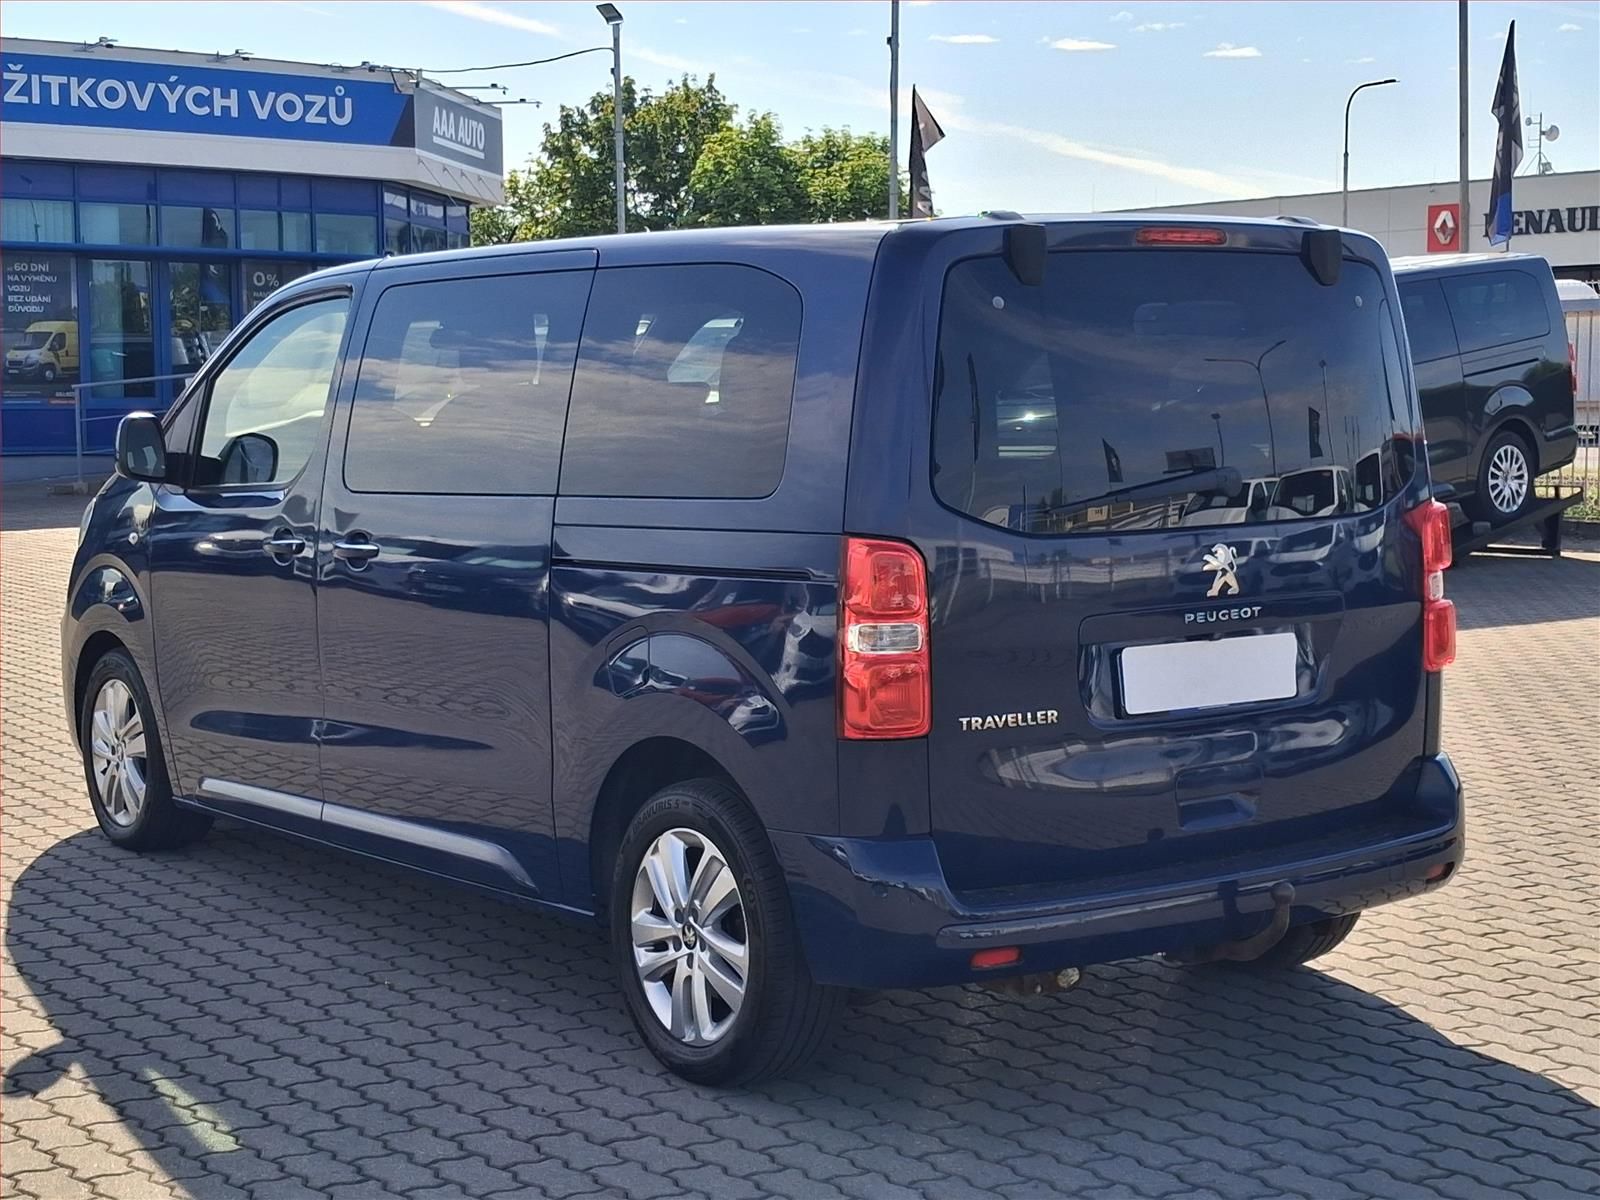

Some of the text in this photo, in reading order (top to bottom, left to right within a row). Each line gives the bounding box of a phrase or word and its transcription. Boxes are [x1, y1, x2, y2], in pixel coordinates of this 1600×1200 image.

[3, 63, 353, 126] ŽITKOVÝCH VOZŮ
[432, 106, 485, 152] AAA AUTO
[14, 262, 28, 272] 60
[30, 261, 49, 273] DNÍ
[7, 274, 20, 282] NA
[253, 271, 280, 287] 0%
[1184, 606, 1263, 624] PEUGEOT
[959, 709, 1059, 732] TRAVELLER
